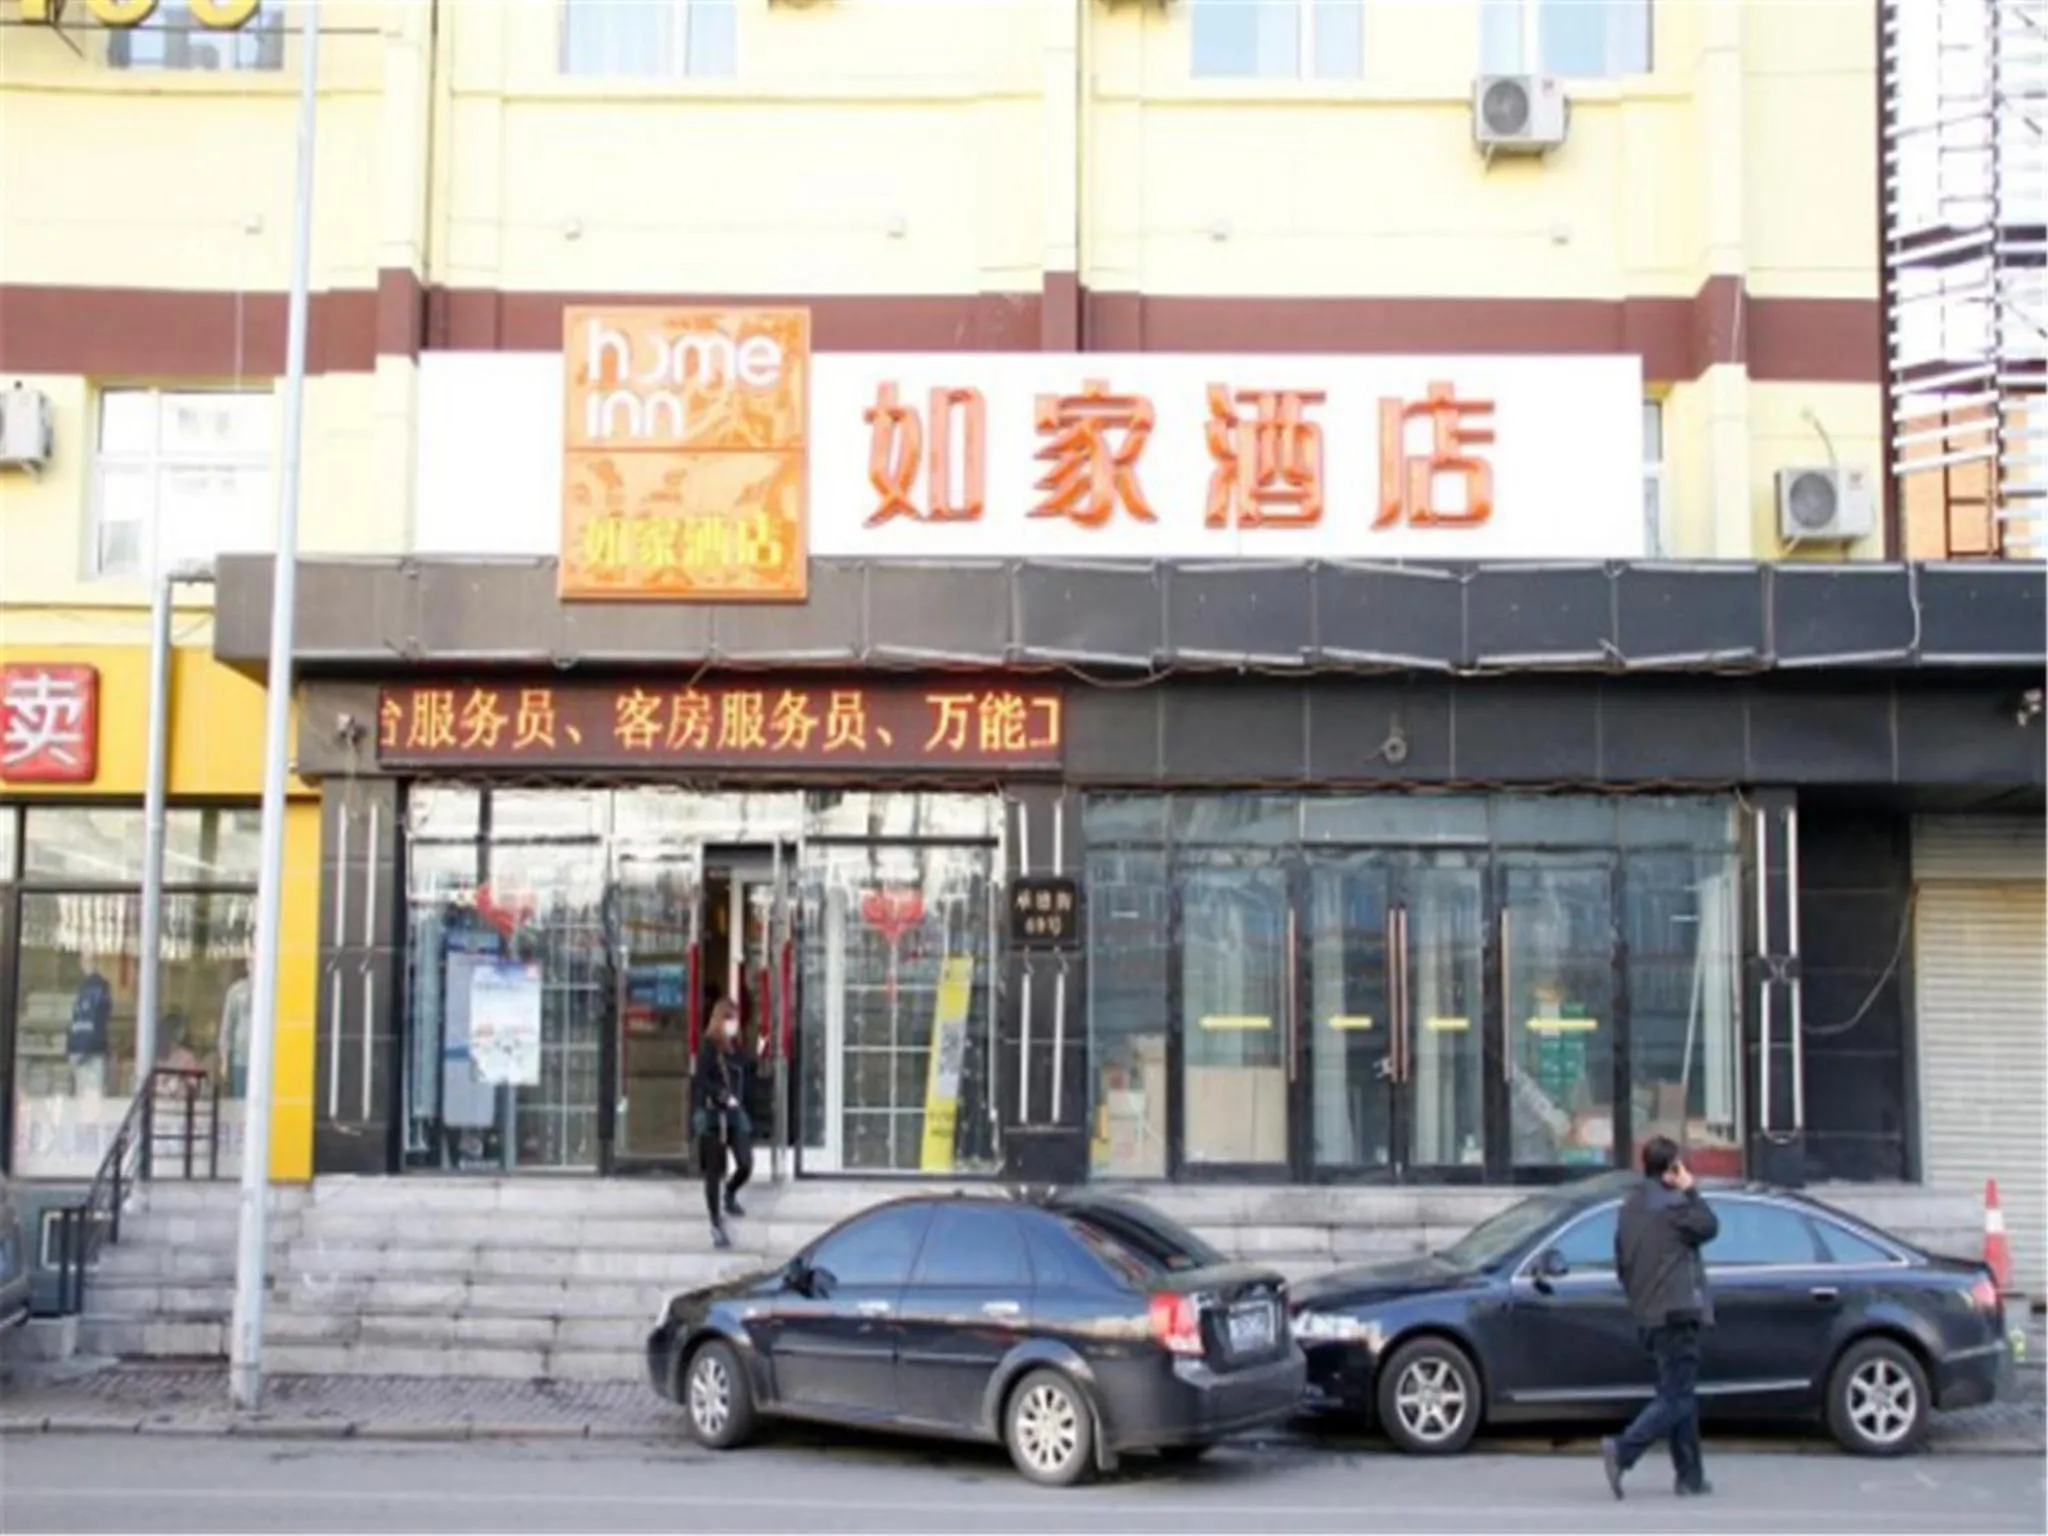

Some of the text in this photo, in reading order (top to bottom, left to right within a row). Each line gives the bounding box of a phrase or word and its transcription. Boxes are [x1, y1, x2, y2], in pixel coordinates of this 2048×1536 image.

[585, 319, 784, 388] home
[585, 389, 685, 440] inn
[862, 377, 1497, 531] 如家酒店
[585, 511, 783, 572] 如家酒店
[2, 673, 84, 766] 卖
